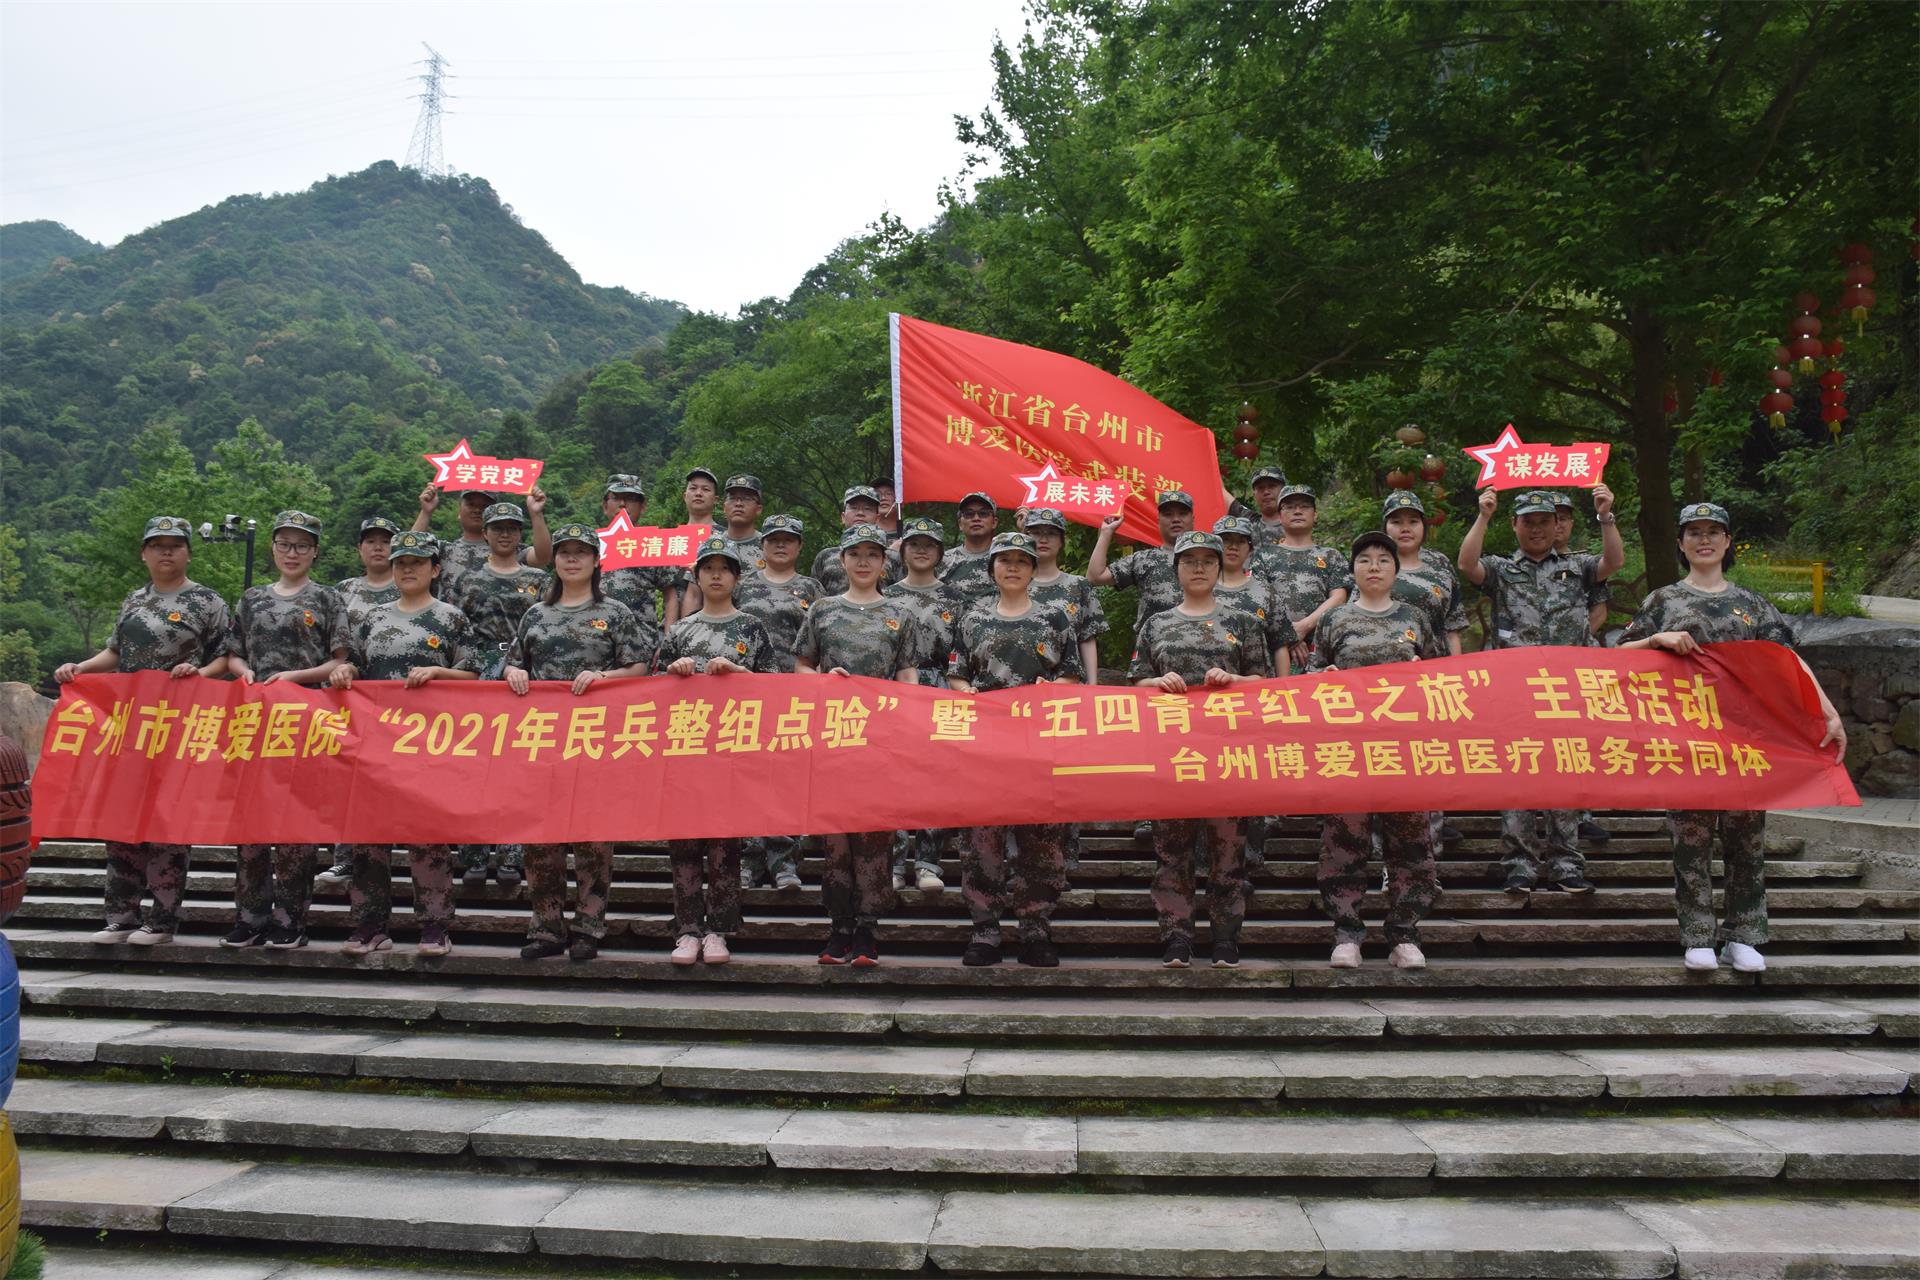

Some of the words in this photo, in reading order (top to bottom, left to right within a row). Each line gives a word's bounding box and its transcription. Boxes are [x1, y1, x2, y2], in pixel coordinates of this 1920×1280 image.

[955, 381, 1164, 452] 浙江省台州市
[455, 463, 524, 487] 学党史
[1505, 452, 1590, 479] 谋发展
[1043, 482, 1115, 507] 展未来
[616, 535, 689, 559] 守清廉
[49, 697, 351, 763] 台州市博爱医院
[930, 700, 976, 742] 暨
[1526, 668, 1723, 731] 主题活动
